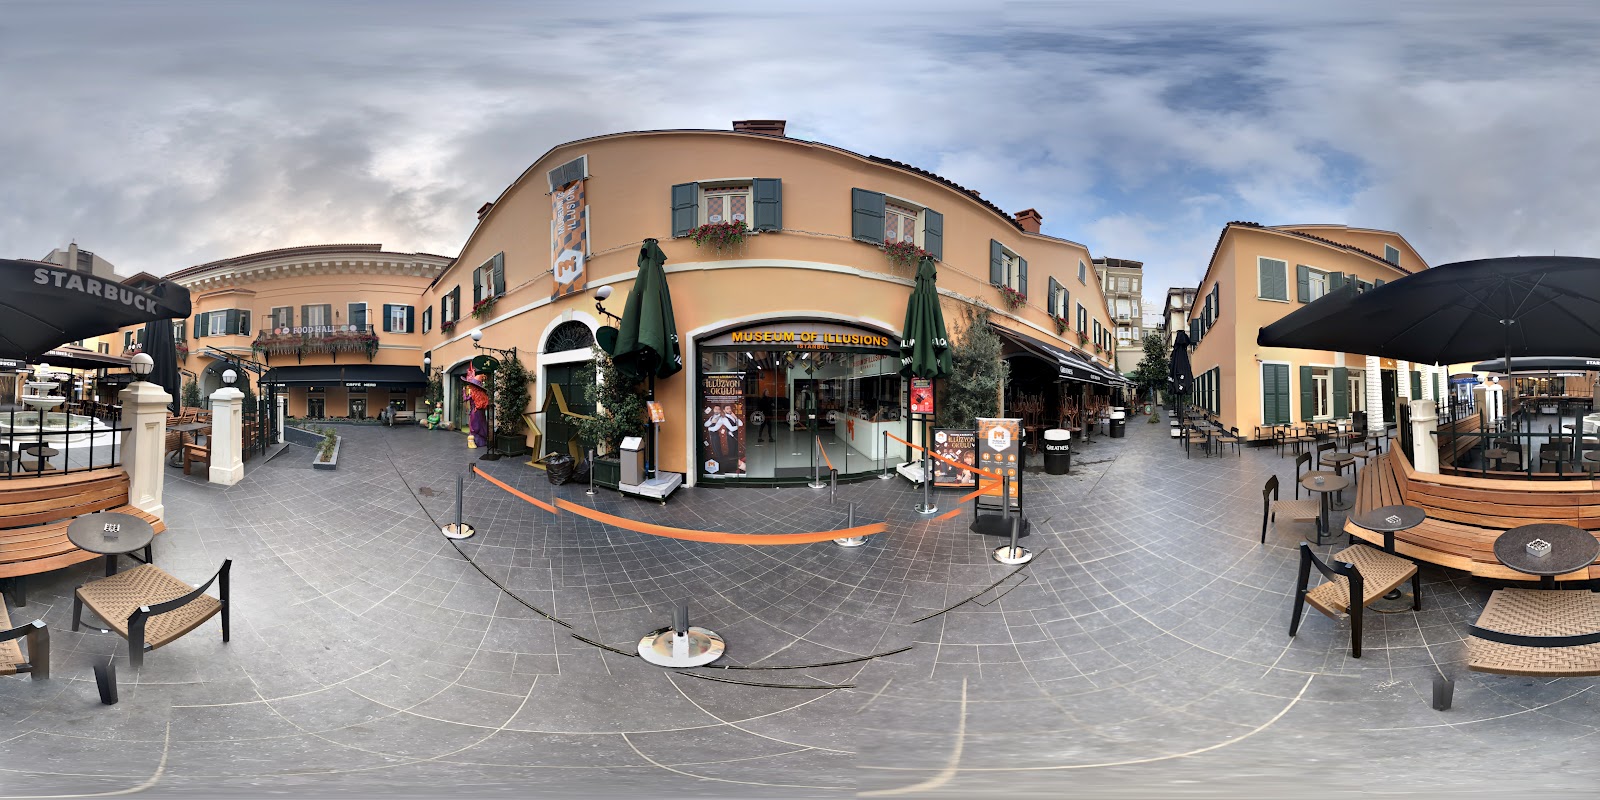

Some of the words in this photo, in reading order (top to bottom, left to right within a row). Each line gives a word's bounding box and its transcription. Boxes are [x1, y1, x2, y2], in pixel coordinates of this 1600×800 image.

[33, 268, 157, 315] STARBUCK
[293, 326, 313, 334] FOOD
[316, 325, 336, 333] HALL
[731, 332, 794, 343] MUSEUM
[801, 331, 817, 343] OF
[824, 333, 889, 347] ILLUSIONS
